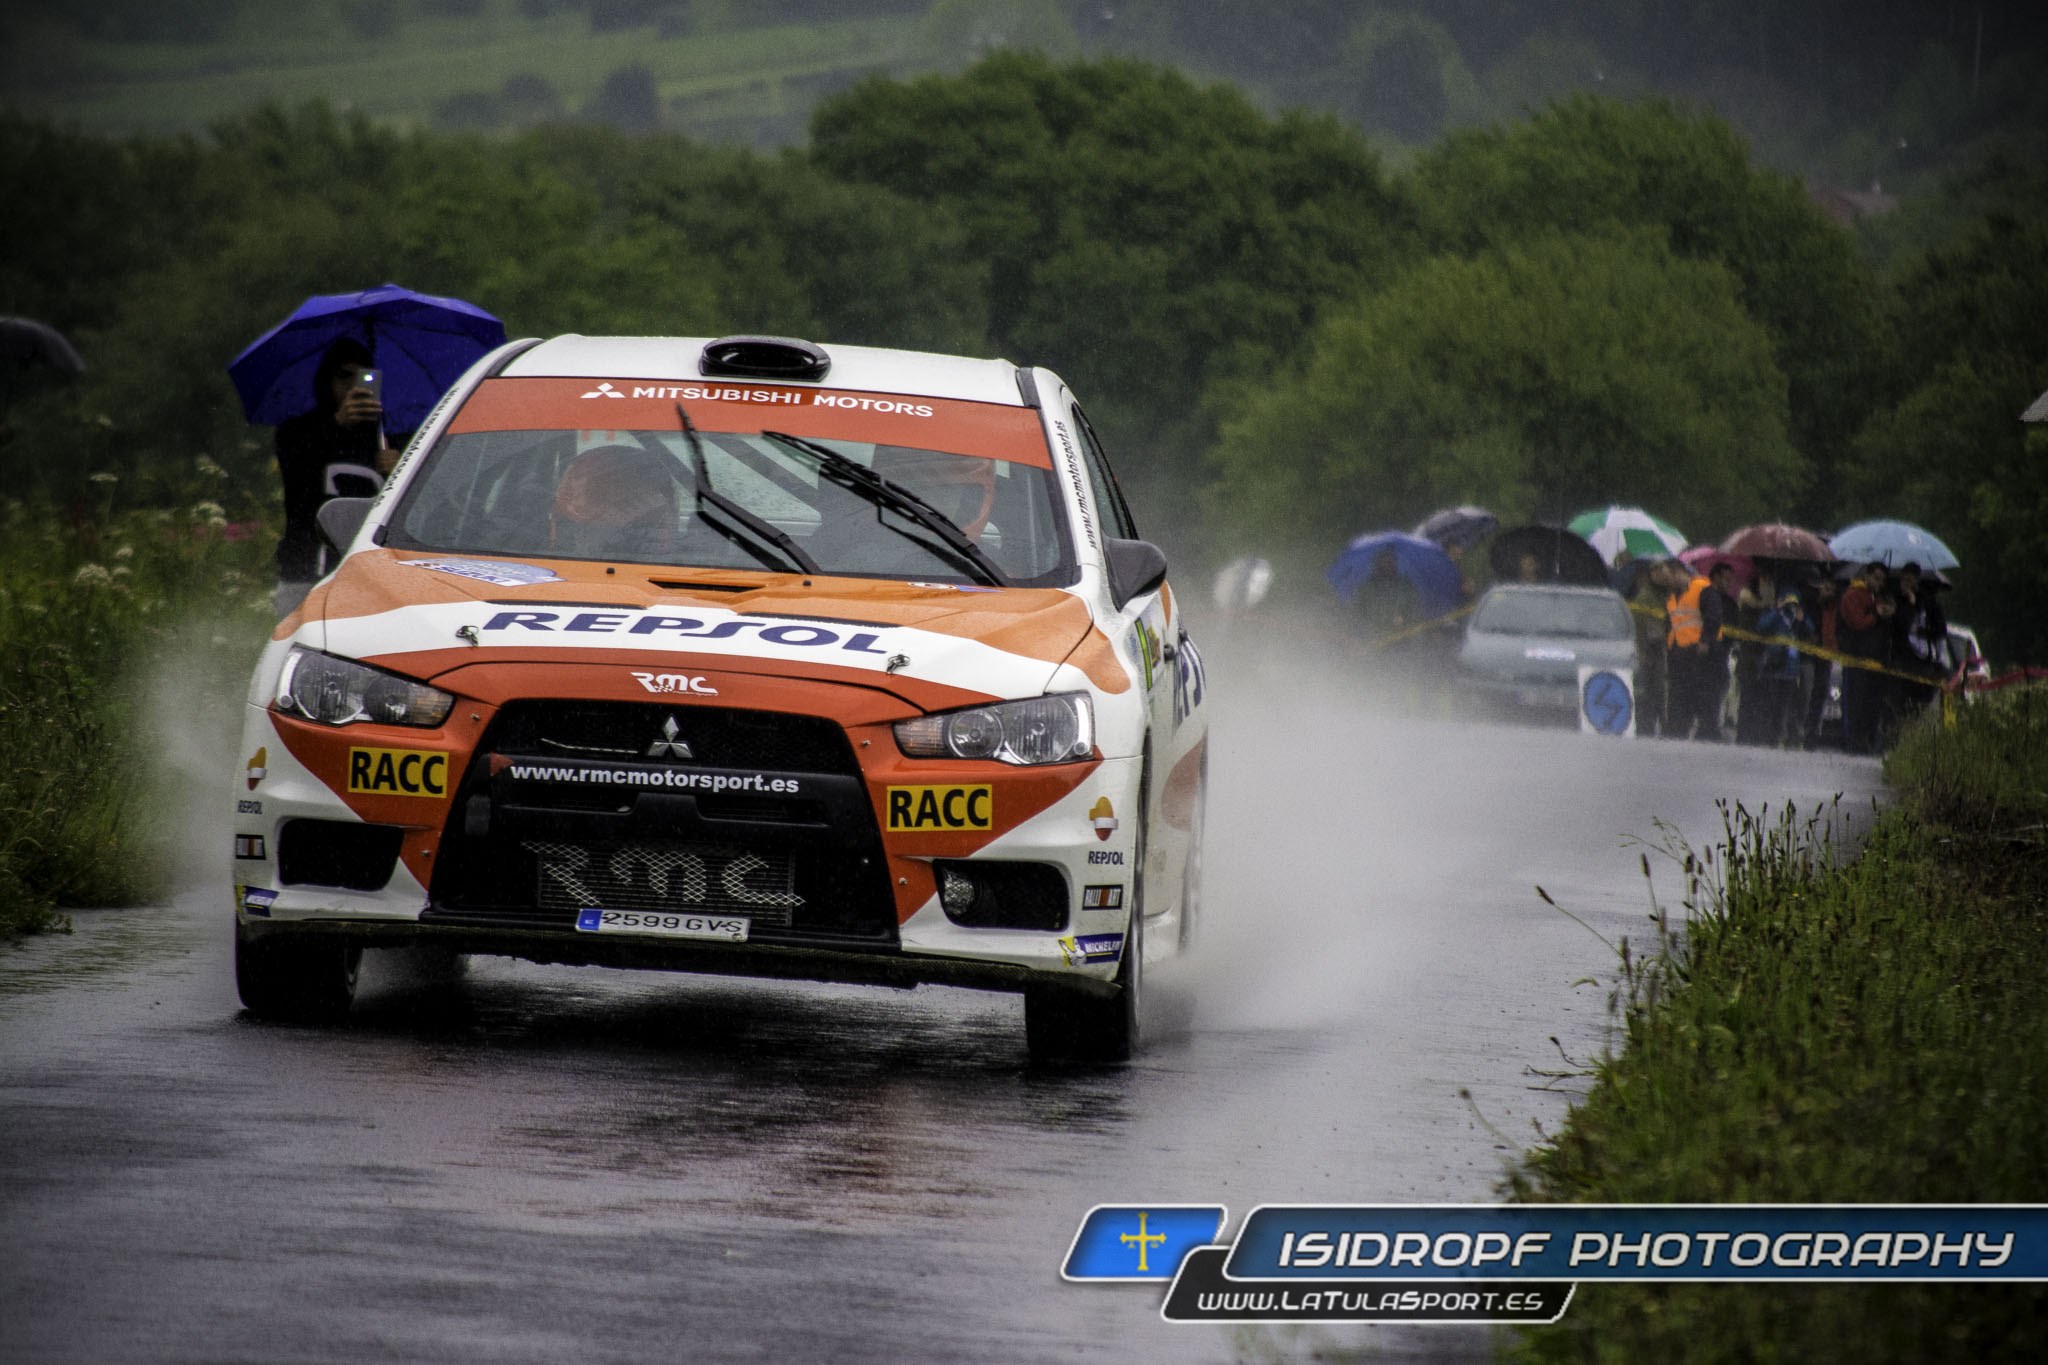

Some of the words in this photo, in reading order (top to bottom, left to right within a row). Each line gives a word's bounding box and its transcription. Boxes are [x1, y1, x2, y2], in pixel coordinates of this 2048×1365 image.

[633, 386, 802, 405] MITSUBISHI
[814, 394, 934, 418] MOTORS
[482, 611, 888, 655] REPSOL
[350, 750, 446, 795] RACC
[510, 764, 800, 794] www.rmcmotorsport.es
[889, 787, 990, 829] RACC
[1087, 850, 1125, 866] REPSOL
[602, 911, 681, 930] 2599
[685, 917, 744, 933] GVS
